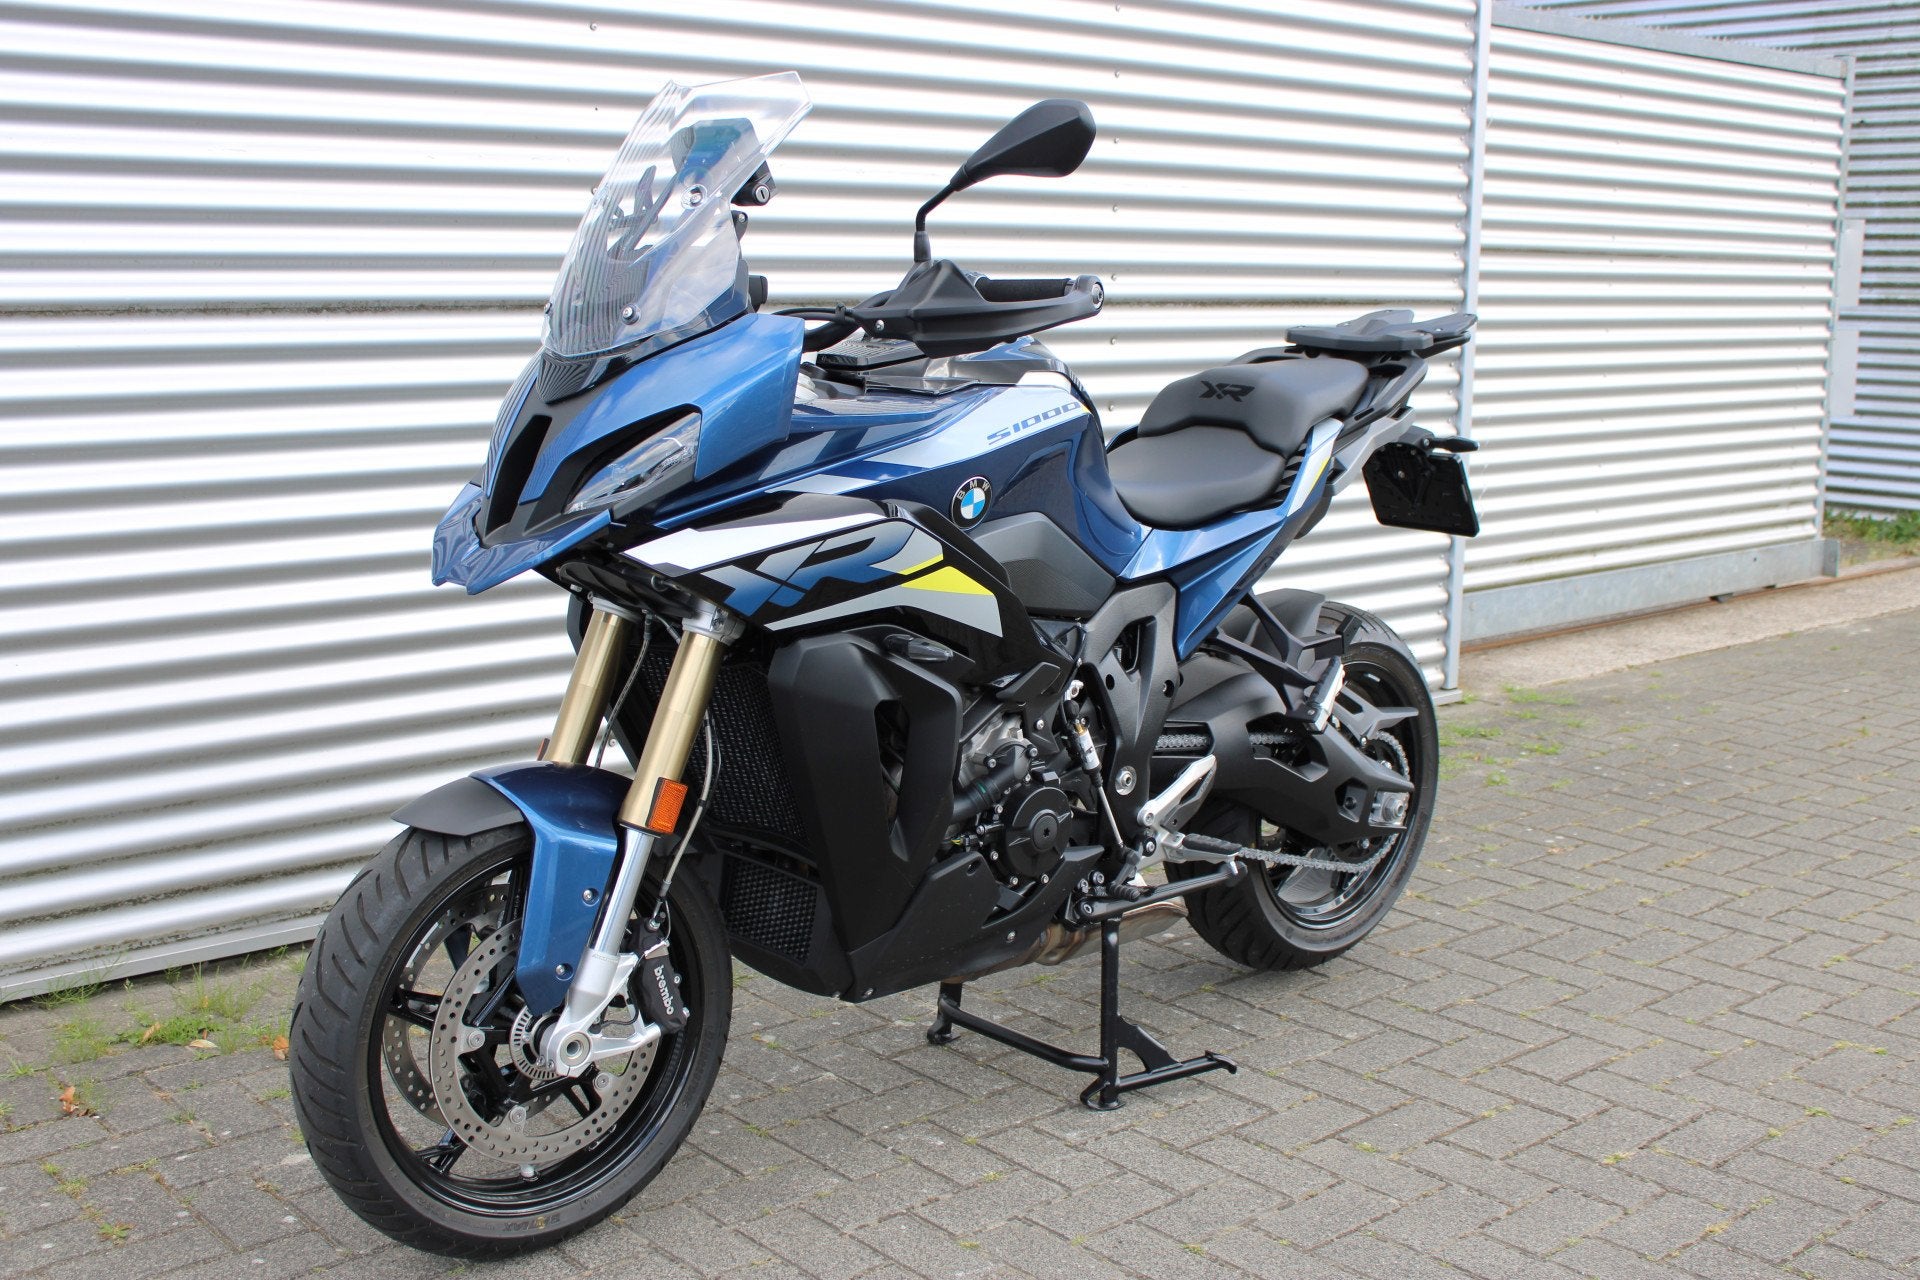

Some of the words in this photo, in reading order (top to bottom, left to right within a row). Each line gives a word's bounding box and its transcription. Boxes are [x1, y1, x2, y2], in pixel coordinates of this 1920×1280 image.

[1199, 380, 1256, 403] XR
[986, 401, 1081, 446] S1000
[956, 478, 991, 501] BMW
[654, 964, 675, 1016] brembo
